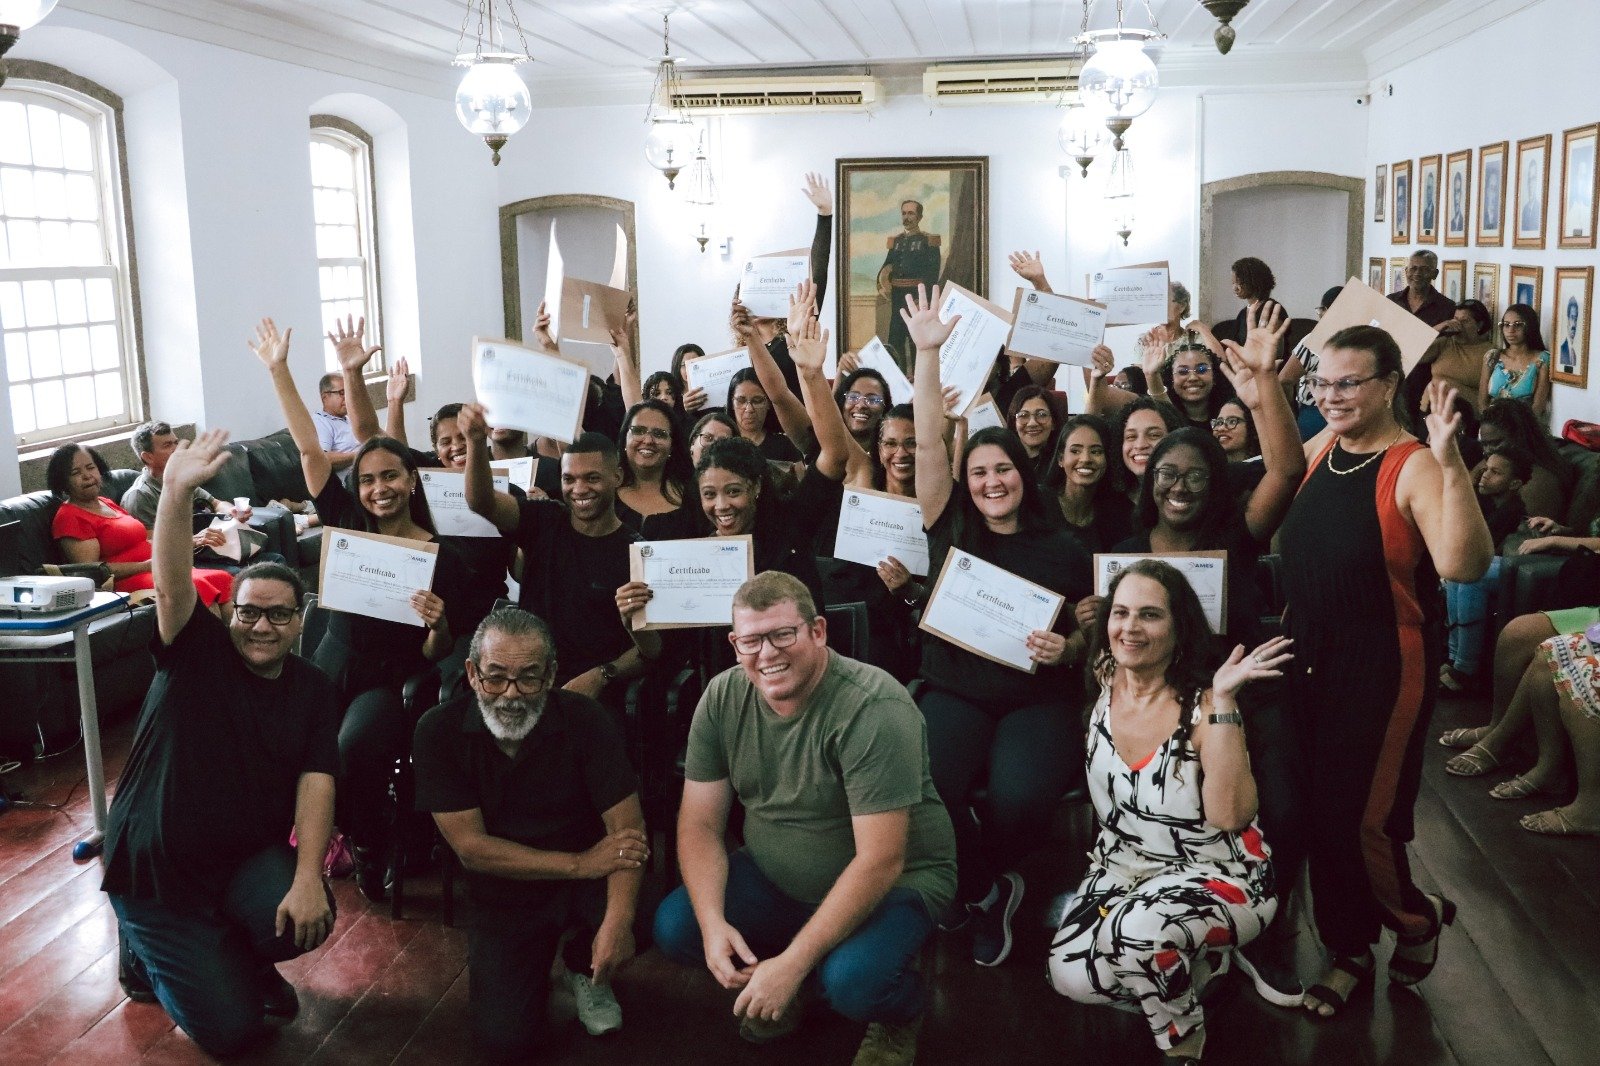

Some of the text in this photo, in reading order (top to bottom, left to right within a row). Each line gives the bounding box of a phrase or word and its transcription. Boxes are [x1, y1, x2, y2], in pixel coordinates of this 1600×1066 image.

[869, 518, 904, 531] Certificado
[359, 564, 396, 579] Certificado
[668, 566, 710, 574] Certificado
[976, 588, 1015, 612] Certificado
[1033, 593, 1050, 604] AMES
